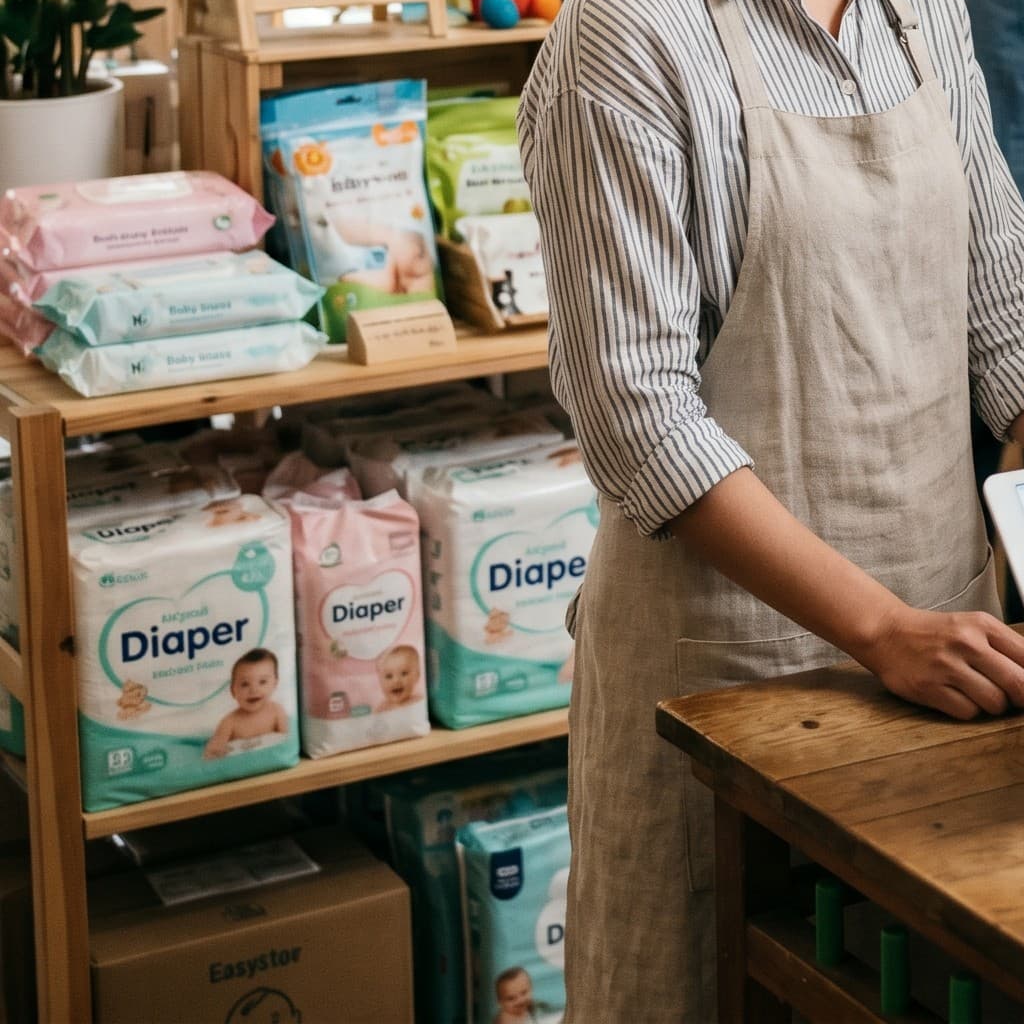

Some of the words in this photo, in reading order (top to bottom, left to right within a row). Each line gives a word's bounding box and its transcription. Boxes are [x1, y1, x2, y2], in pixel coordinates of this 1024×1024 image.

[489, 556, 586, 592] Diape
[332, 596, 405, 623] Diaper
[121, 618, 249, 663] Diaper
[209, 946, 303, 984] Easystor
